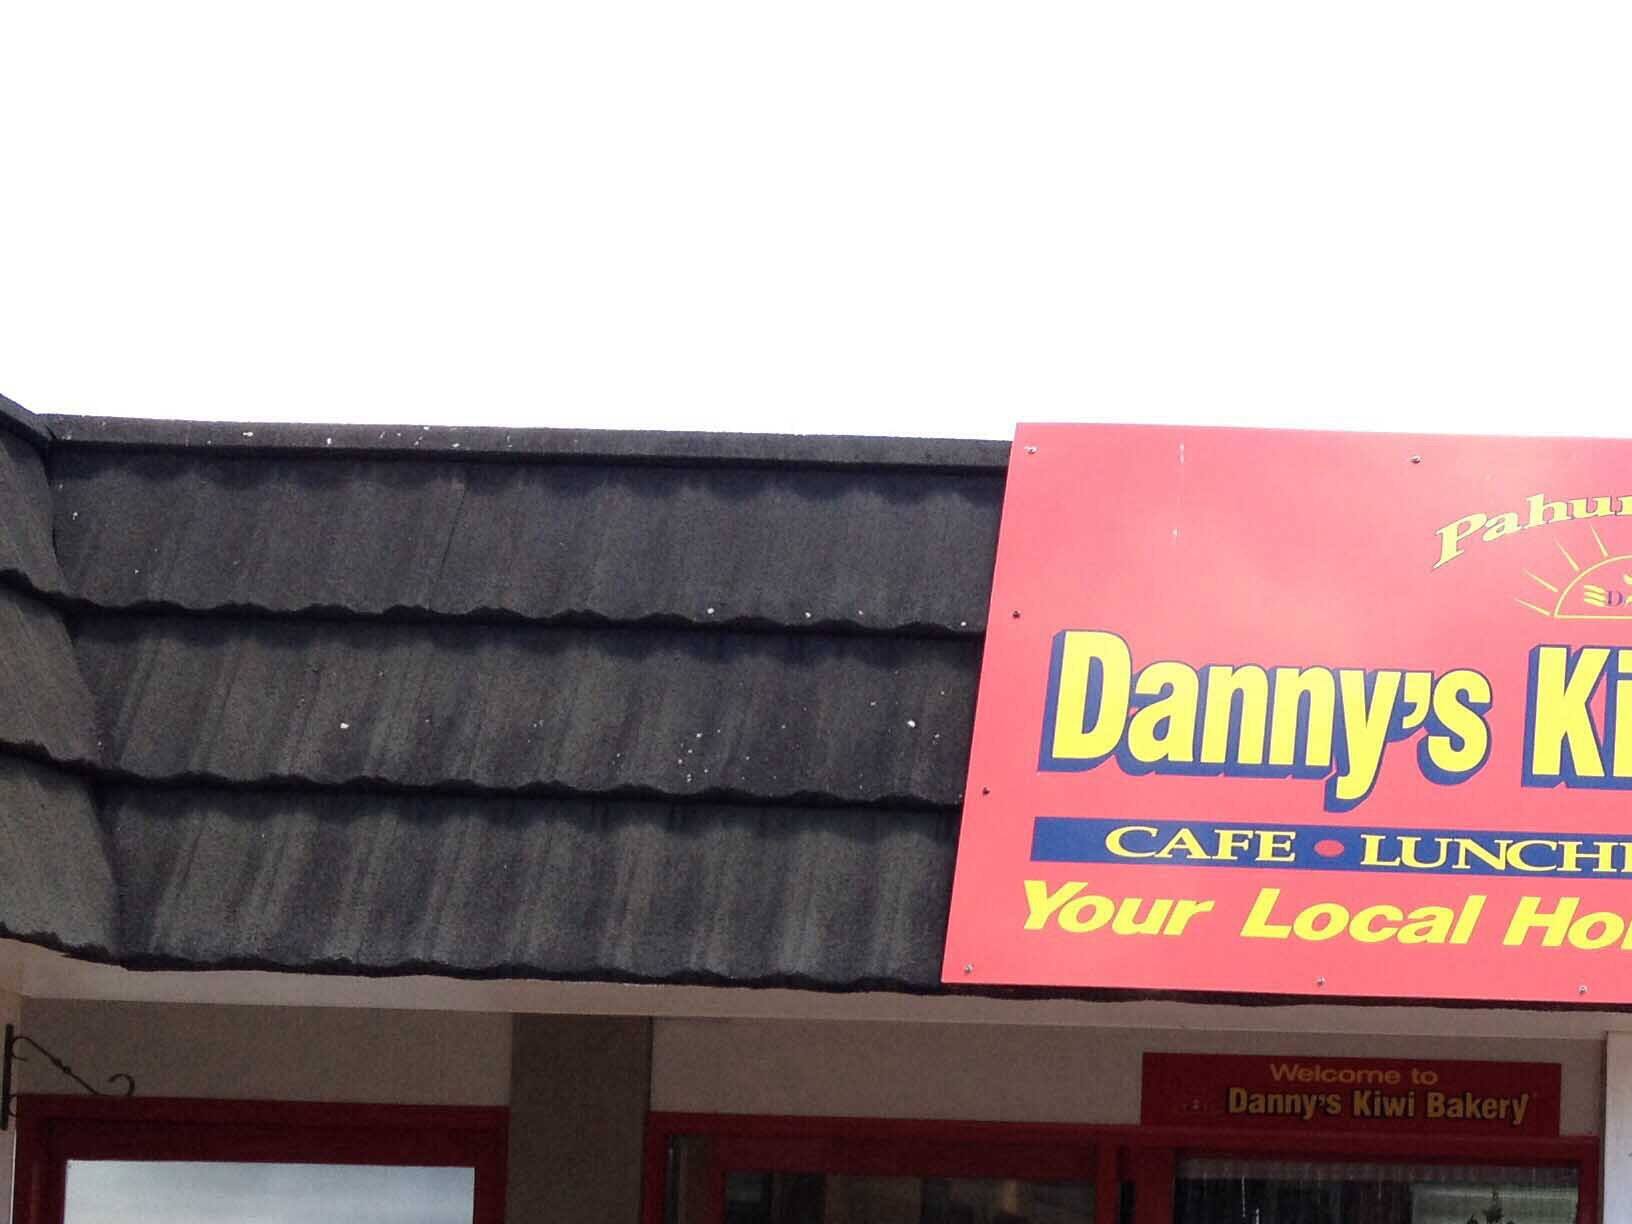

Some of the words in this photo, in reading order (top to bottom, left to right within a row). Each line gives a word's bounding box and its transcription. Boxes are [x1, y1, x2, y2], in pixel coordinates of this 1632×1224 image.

[1038, 630, 1492, 811] Danny's
[1105, 826, 1297, 862] CAFE
[1022, 880, 1212, 936] Your
[1240, 888, 1485, 945] Local
[1270, 1063, 1400, 1084] Welcome
[1411, 1068, 1439, 1085] to
[1227, 1087, 1343, 1121] Danny's
[1353, 1089, 1416, 1118] Kiwi
[1426, 1092, 1530, 1125] Bakery
